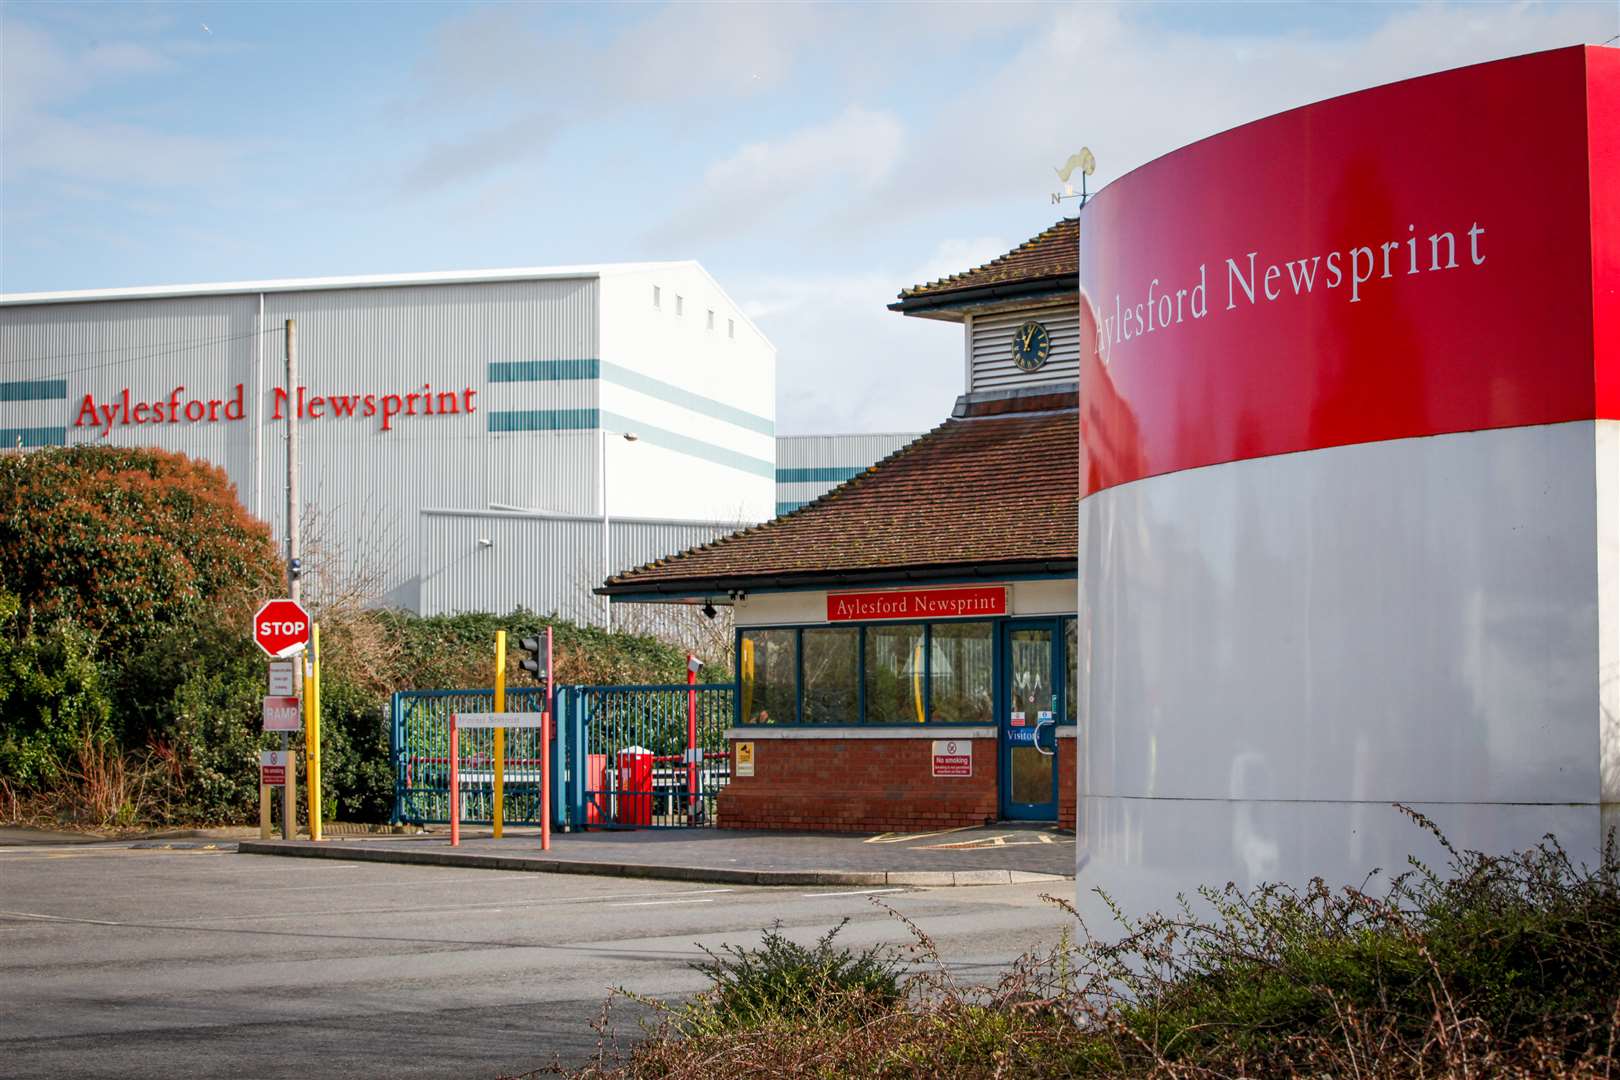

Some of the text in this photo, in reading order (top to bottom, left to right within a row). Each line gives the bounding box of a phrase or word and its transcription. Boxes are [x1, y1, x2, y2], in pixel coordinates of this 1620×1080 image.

[1093, 263, 1208, 368] Aylesford
[1225, 221, 1487, 311] Newsprint
[74, 383, 478, 437] Aylesford Newsprint
[836, 593, 996, 618] Aylesford Newsprint
[260, 621, 306, 636] STOP
[266, 707, 298, 720] RAMP
[945, 757, 969, 766] smoking
